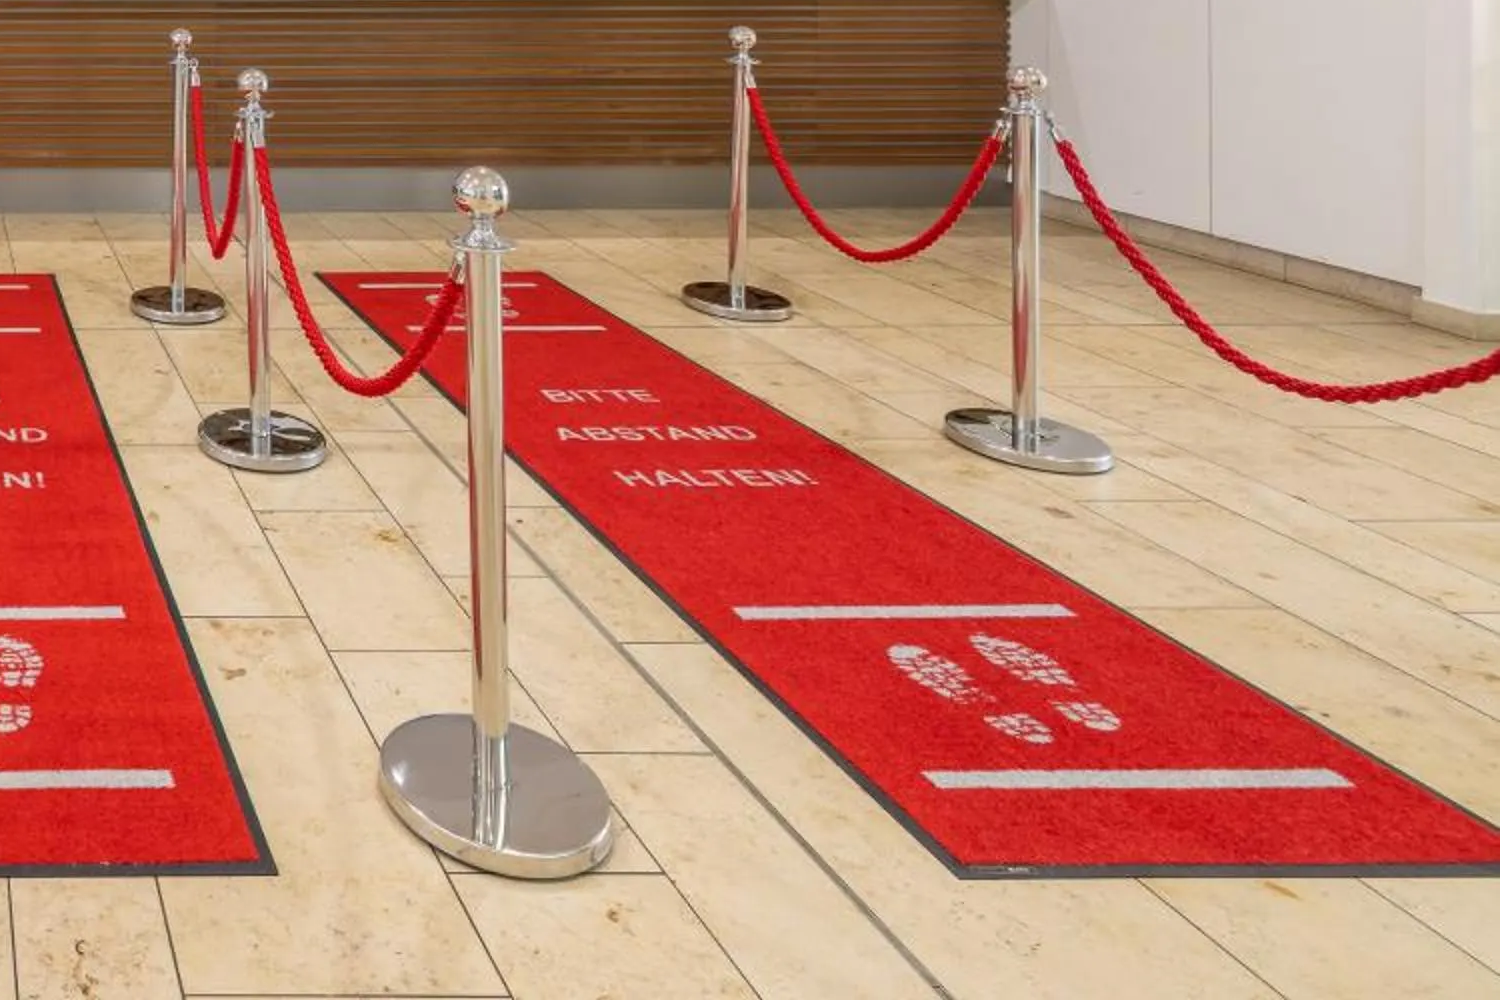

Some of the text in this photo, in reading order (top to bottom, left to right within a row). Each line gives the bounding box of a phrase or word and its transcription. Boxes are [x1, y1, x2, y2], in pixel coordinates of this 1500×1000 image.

[540, 388, 660, 403] BITTE
[556, 426, 758, 441] ABSTAND
[613, 469, 819, 487] HALTEN!
